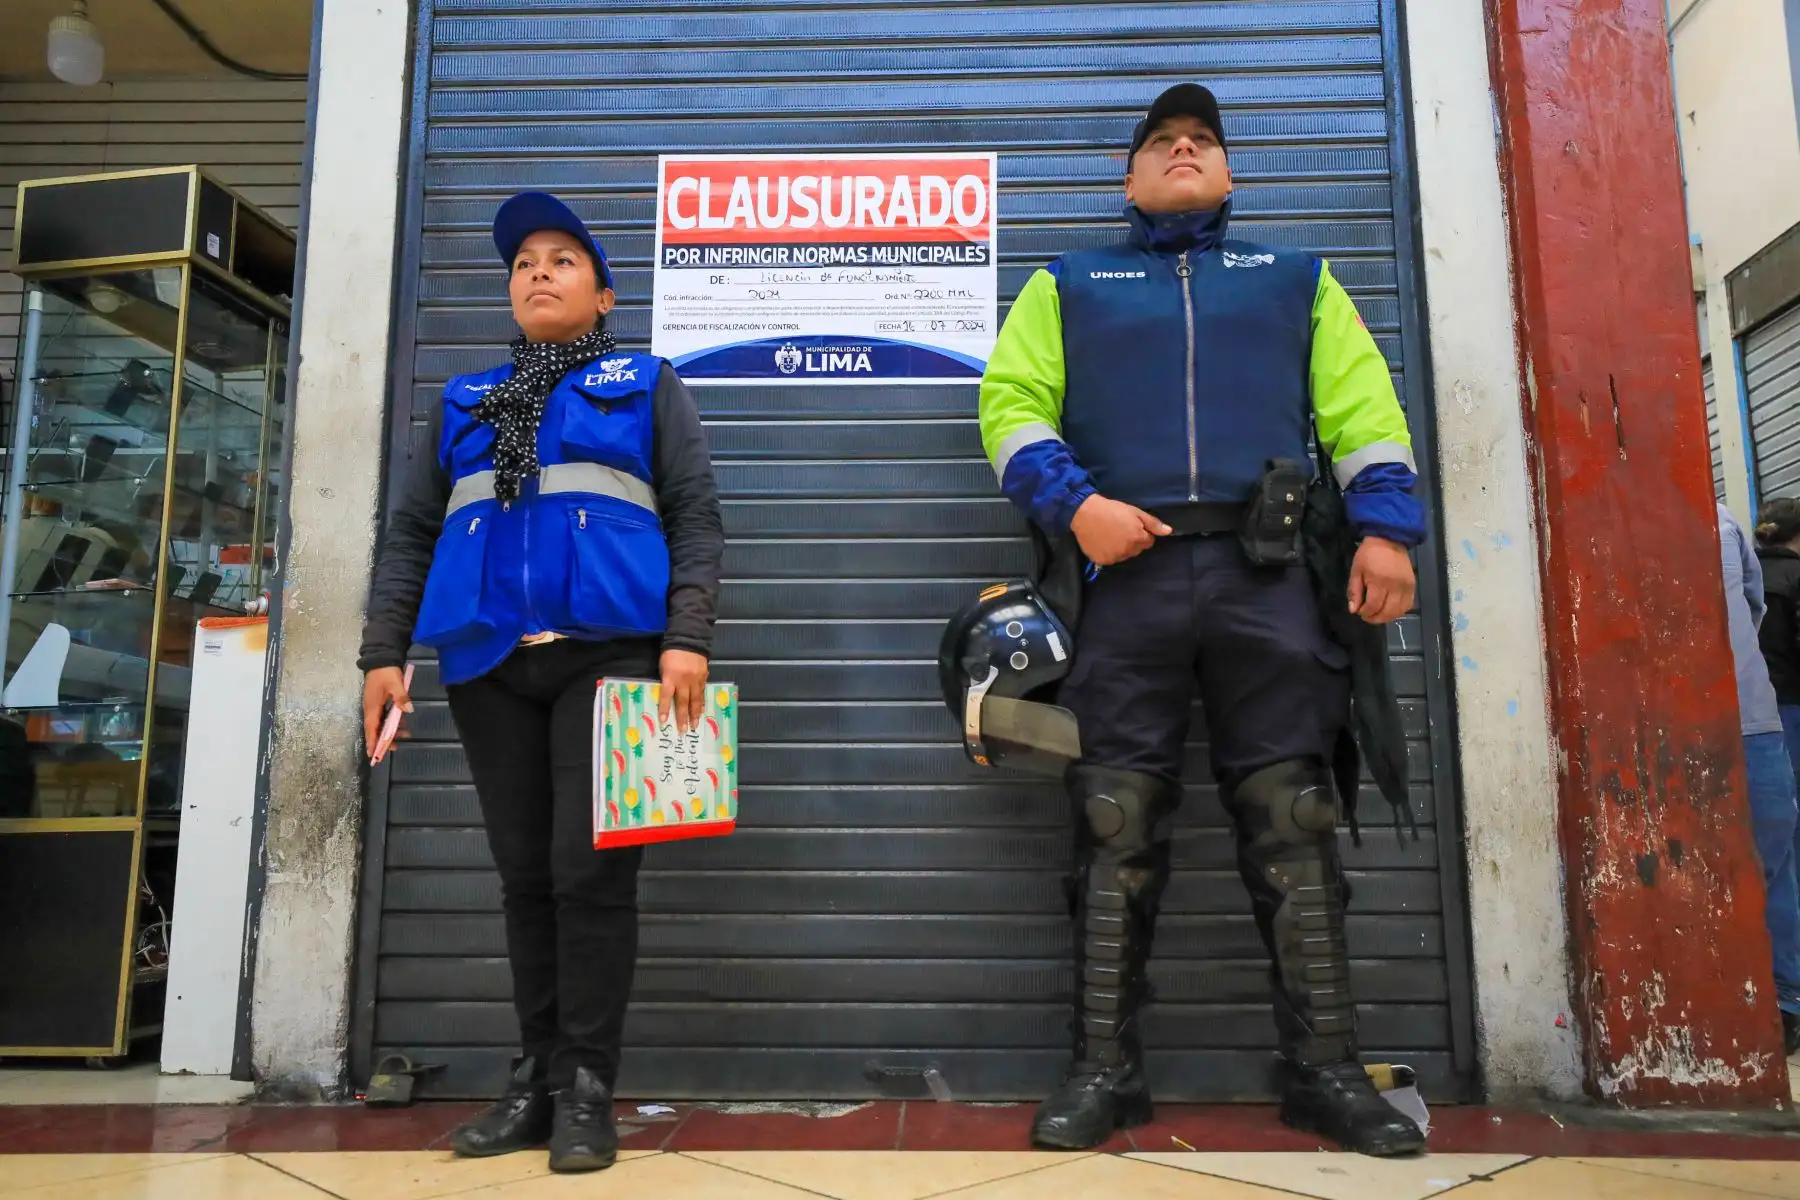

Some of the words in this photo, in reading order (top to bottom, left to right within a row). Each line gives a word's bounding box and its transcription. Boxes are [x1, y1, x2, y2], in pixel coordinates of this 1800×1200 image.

[668, 175, 987, 230] CLAUSURADO
[665, 248, 700, 265] POR
[704, 247, 789, 264] INFRINGIR
[793, 246, 868, 264] NORMAS
[871, 245, 986, 264] MUNICIPALES
[1090, 271, 1146, 279] UNOES
[662, 323, 697, 331] GERENCIA
[698, 323, 709, 331] DE
[709, 322, 761, 331] FISCALIZACIÓN
[761, 323, 767, 331] Y
[767, 322, 801, 330] CONTROL
[806, 353, 873, 372] LIMA
[585, 370, 637, 386] LIMA
[674, 736, 686, 754] the
[660, 754, 675, 785] Say
[675, 760, 686, 771] to
